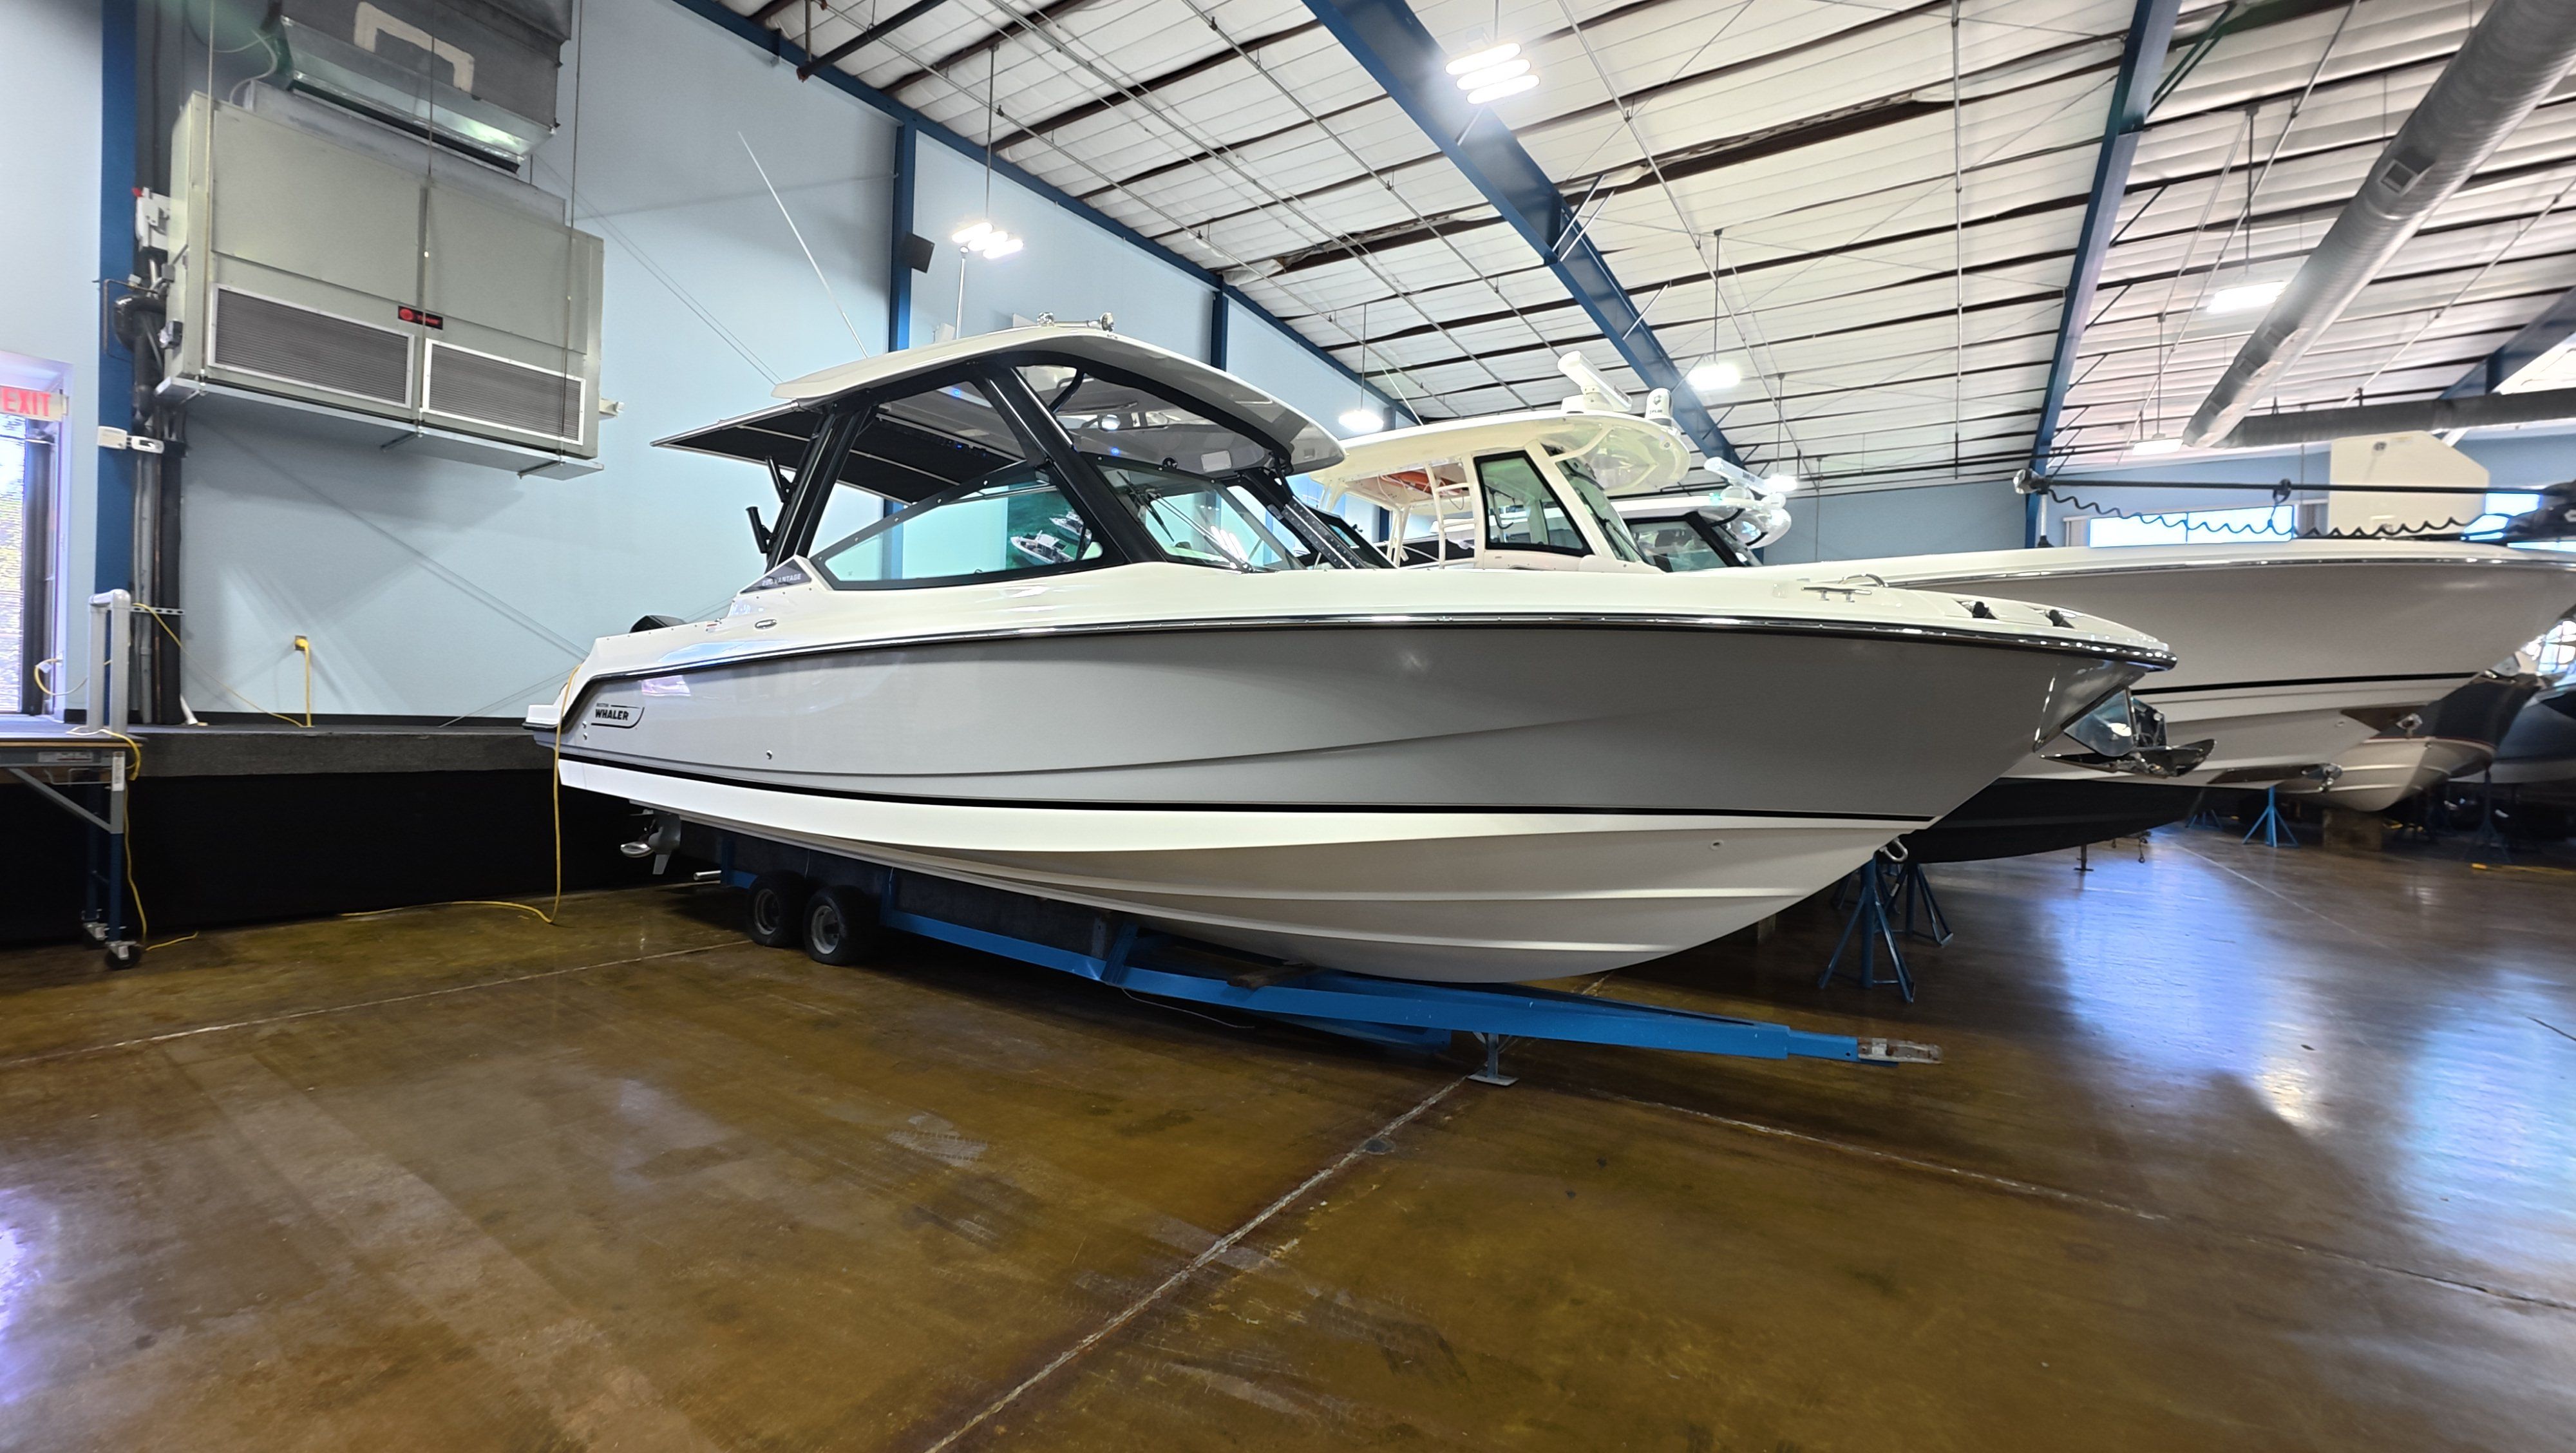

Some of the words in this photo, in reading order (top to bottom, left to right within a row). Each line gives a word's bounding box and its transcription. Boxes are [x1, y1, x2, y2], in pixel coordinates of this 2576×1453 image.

[3, 387, 51, 417] EXIT
[774, 573, 801, 585] VANTAGE
[595, 709, 629, 721] WHALER
